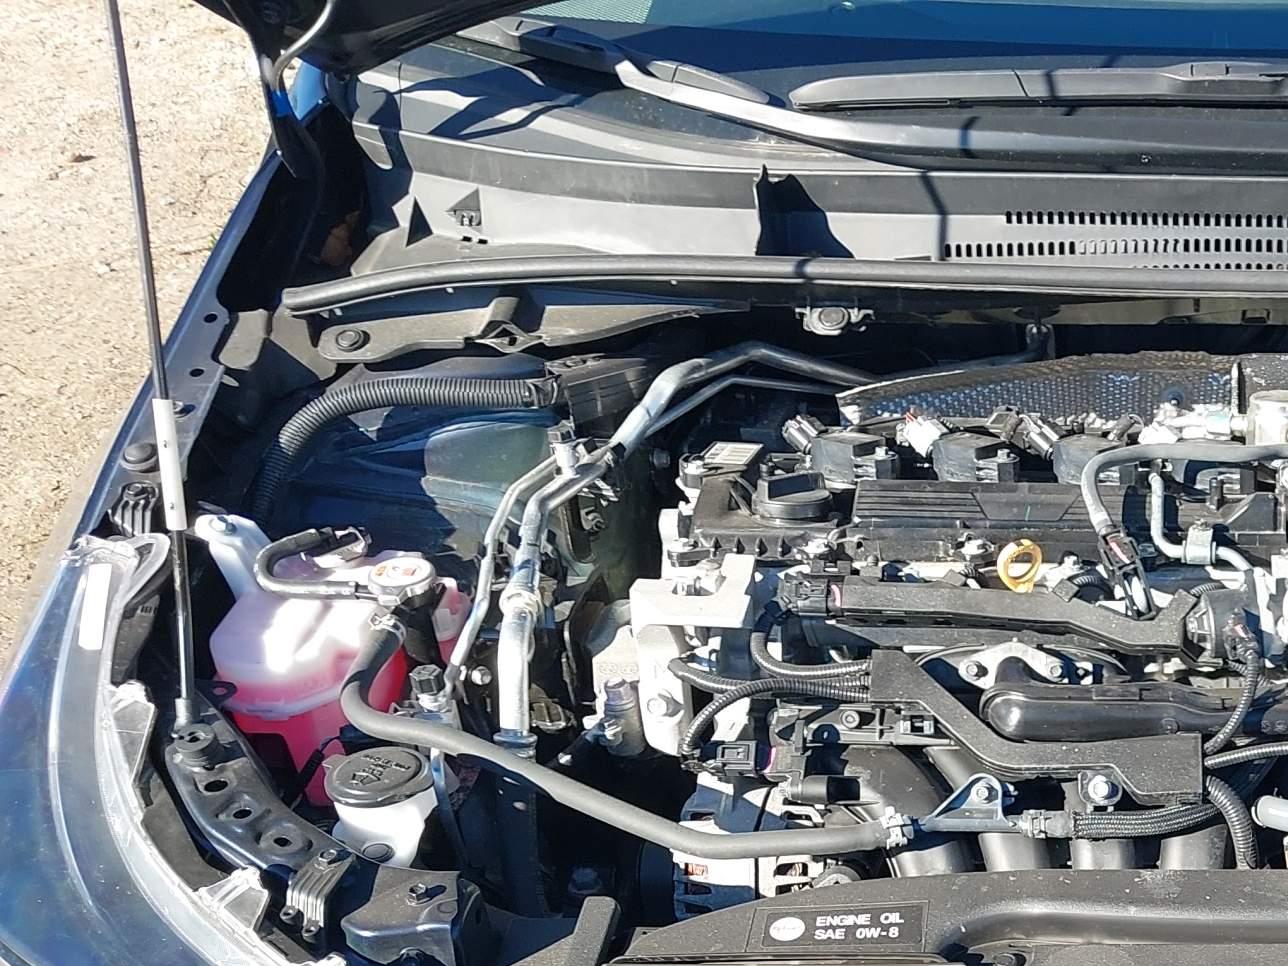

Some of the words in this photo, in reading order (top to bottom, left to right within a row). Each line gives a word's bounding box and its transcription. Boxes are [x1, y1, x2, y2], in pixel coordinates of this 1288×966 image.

[815, 914, 871, 927] ENGINE
[879, 912, 904, 924] OIL
[814, 929, 845, 939] SAE
[856, 927, 899, 939] 0W-8
